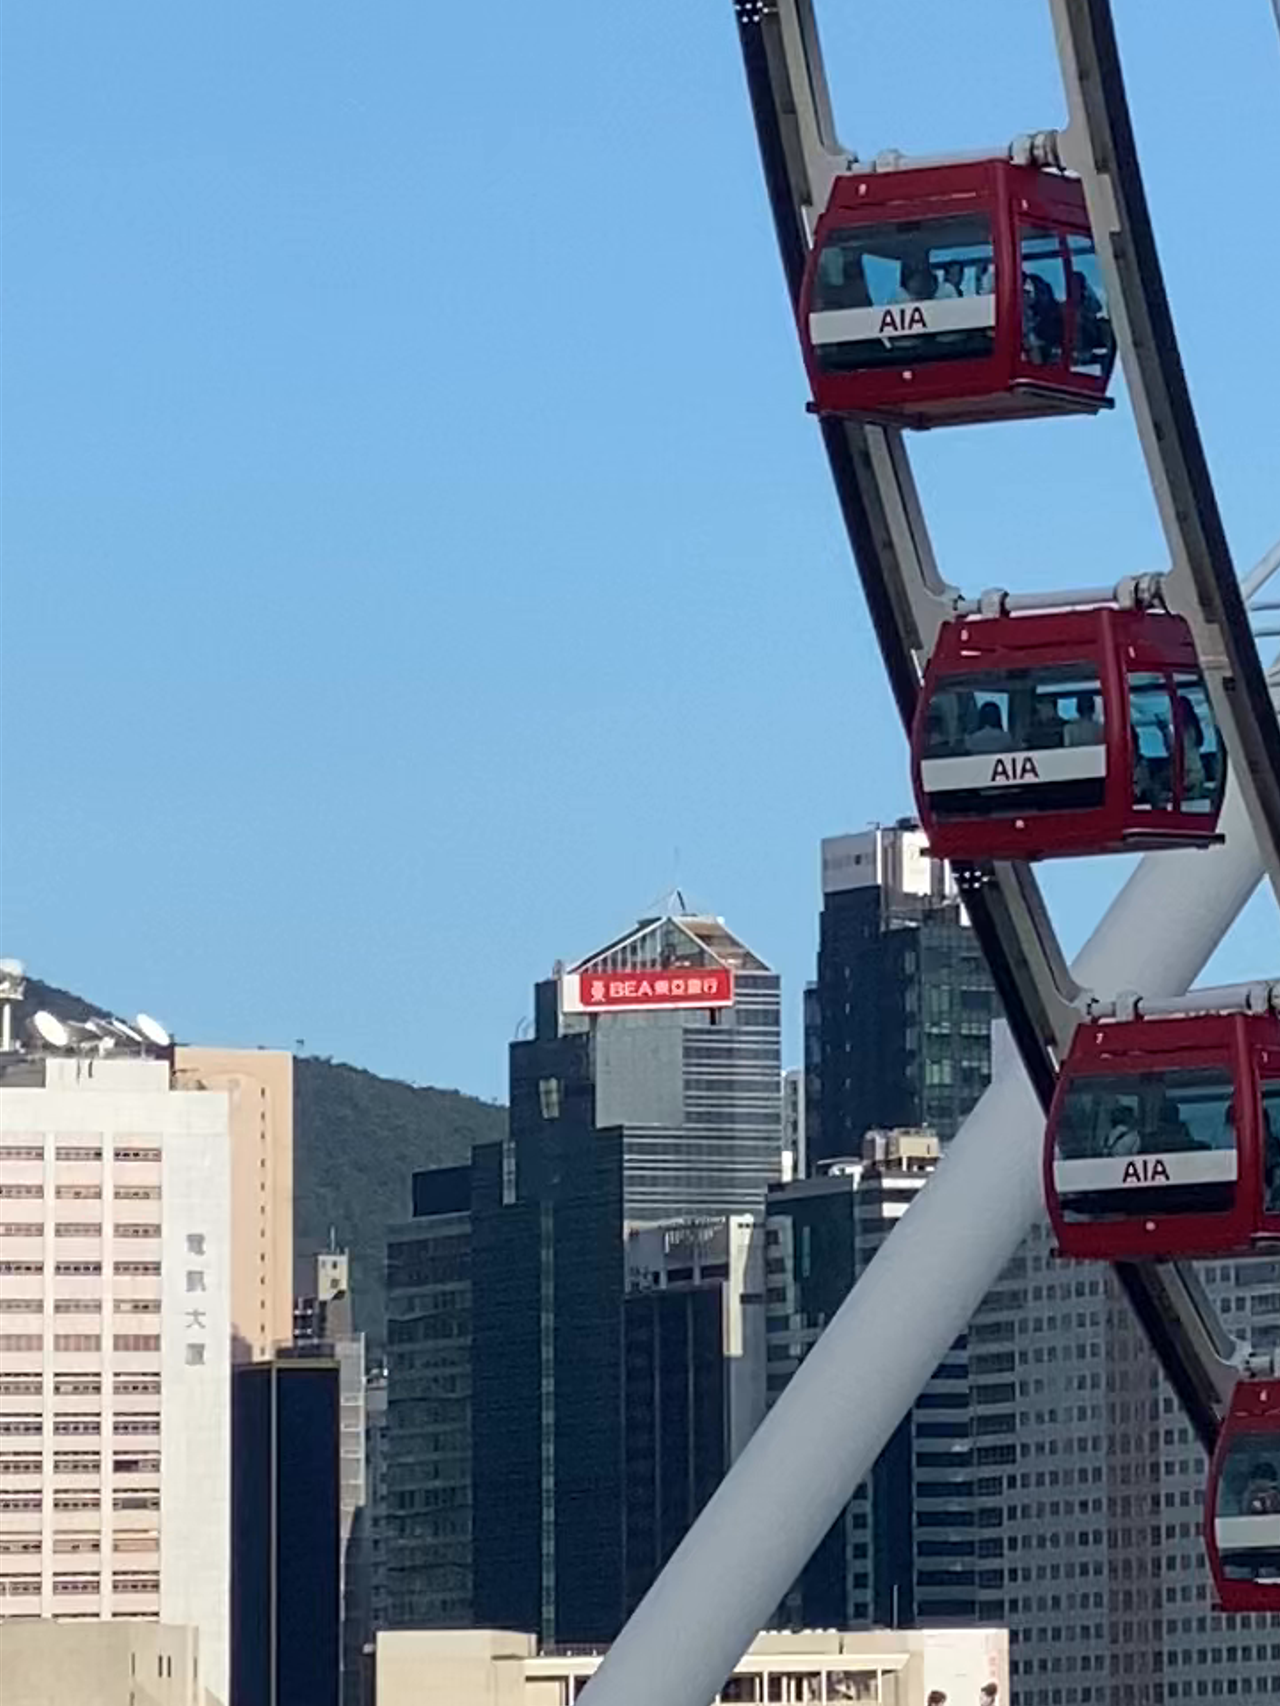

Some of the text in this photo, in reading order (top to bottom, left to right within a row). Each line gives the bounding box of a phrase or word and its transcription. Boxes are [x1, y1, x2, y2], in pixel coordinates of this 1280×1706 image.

[878, 305, 928, 333] AIA
[990, 756, 1039, 782] AIA
[609, 979, 653, 998] BEA
[1121, 1159, 1170, 1183] AIA
